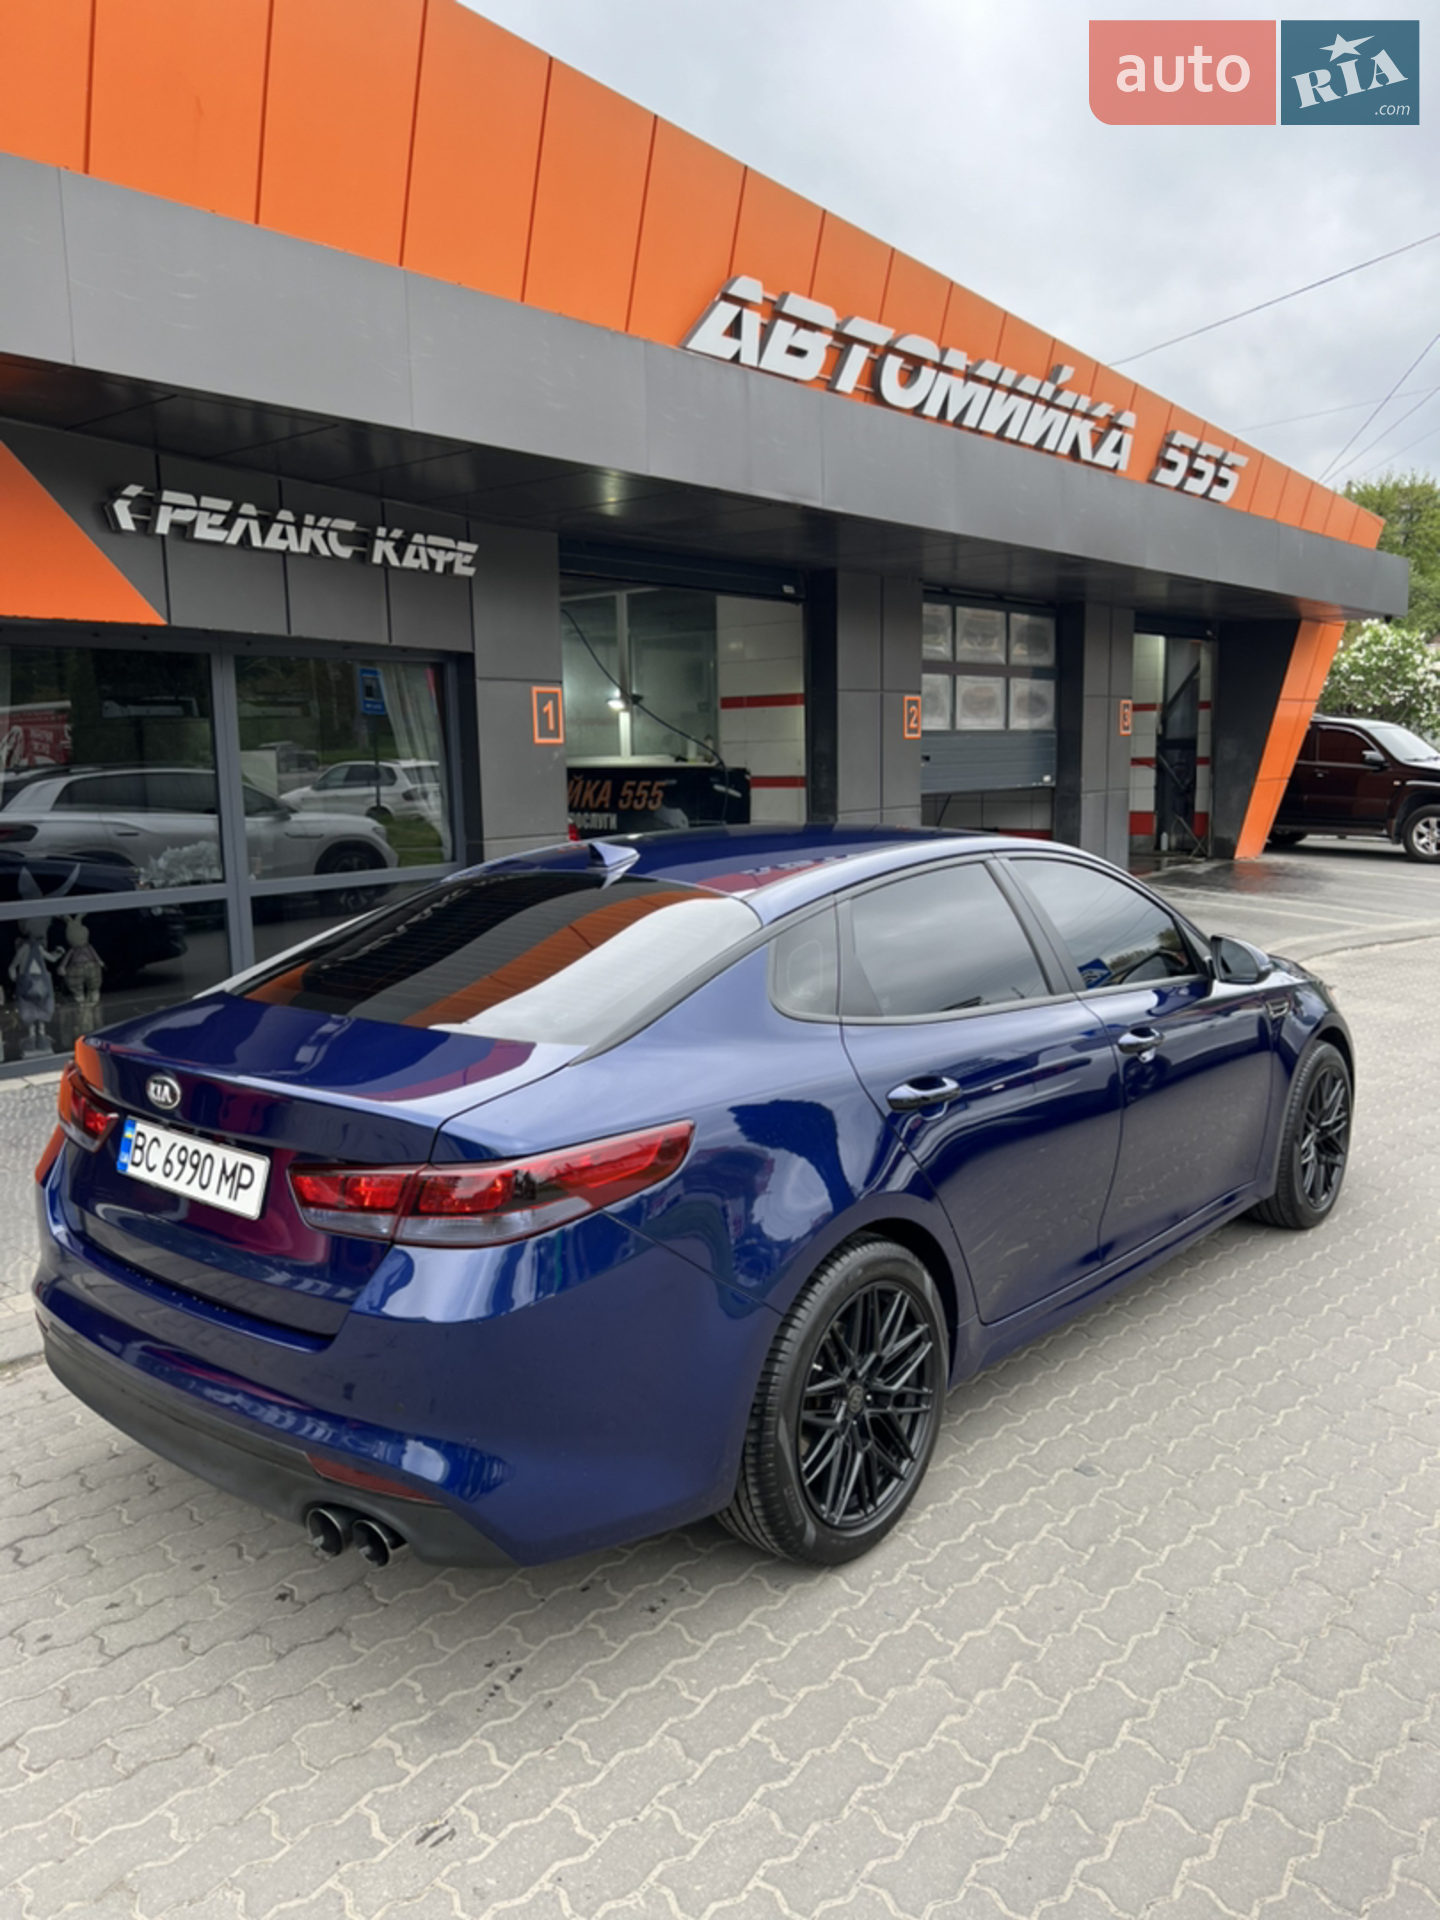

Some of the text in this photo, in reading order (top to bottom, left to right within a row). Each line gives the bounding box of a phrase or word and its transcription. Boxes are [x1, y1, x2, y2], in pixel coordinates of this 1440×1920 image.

[682, 275, 1250, 503] АВТОМИЙКА 555
[152, 489, 357, 560] РЕЛАКС
[542, 700, 555, 731] 1
[909, 705, 918, 729] 2
[1121, 708, 1131, 726] 3
[618, 780, 668, 811] 555
[150, 1082, 172, 1104] KIA
[130, 1131, 255, 1202] BC 6990 MP
